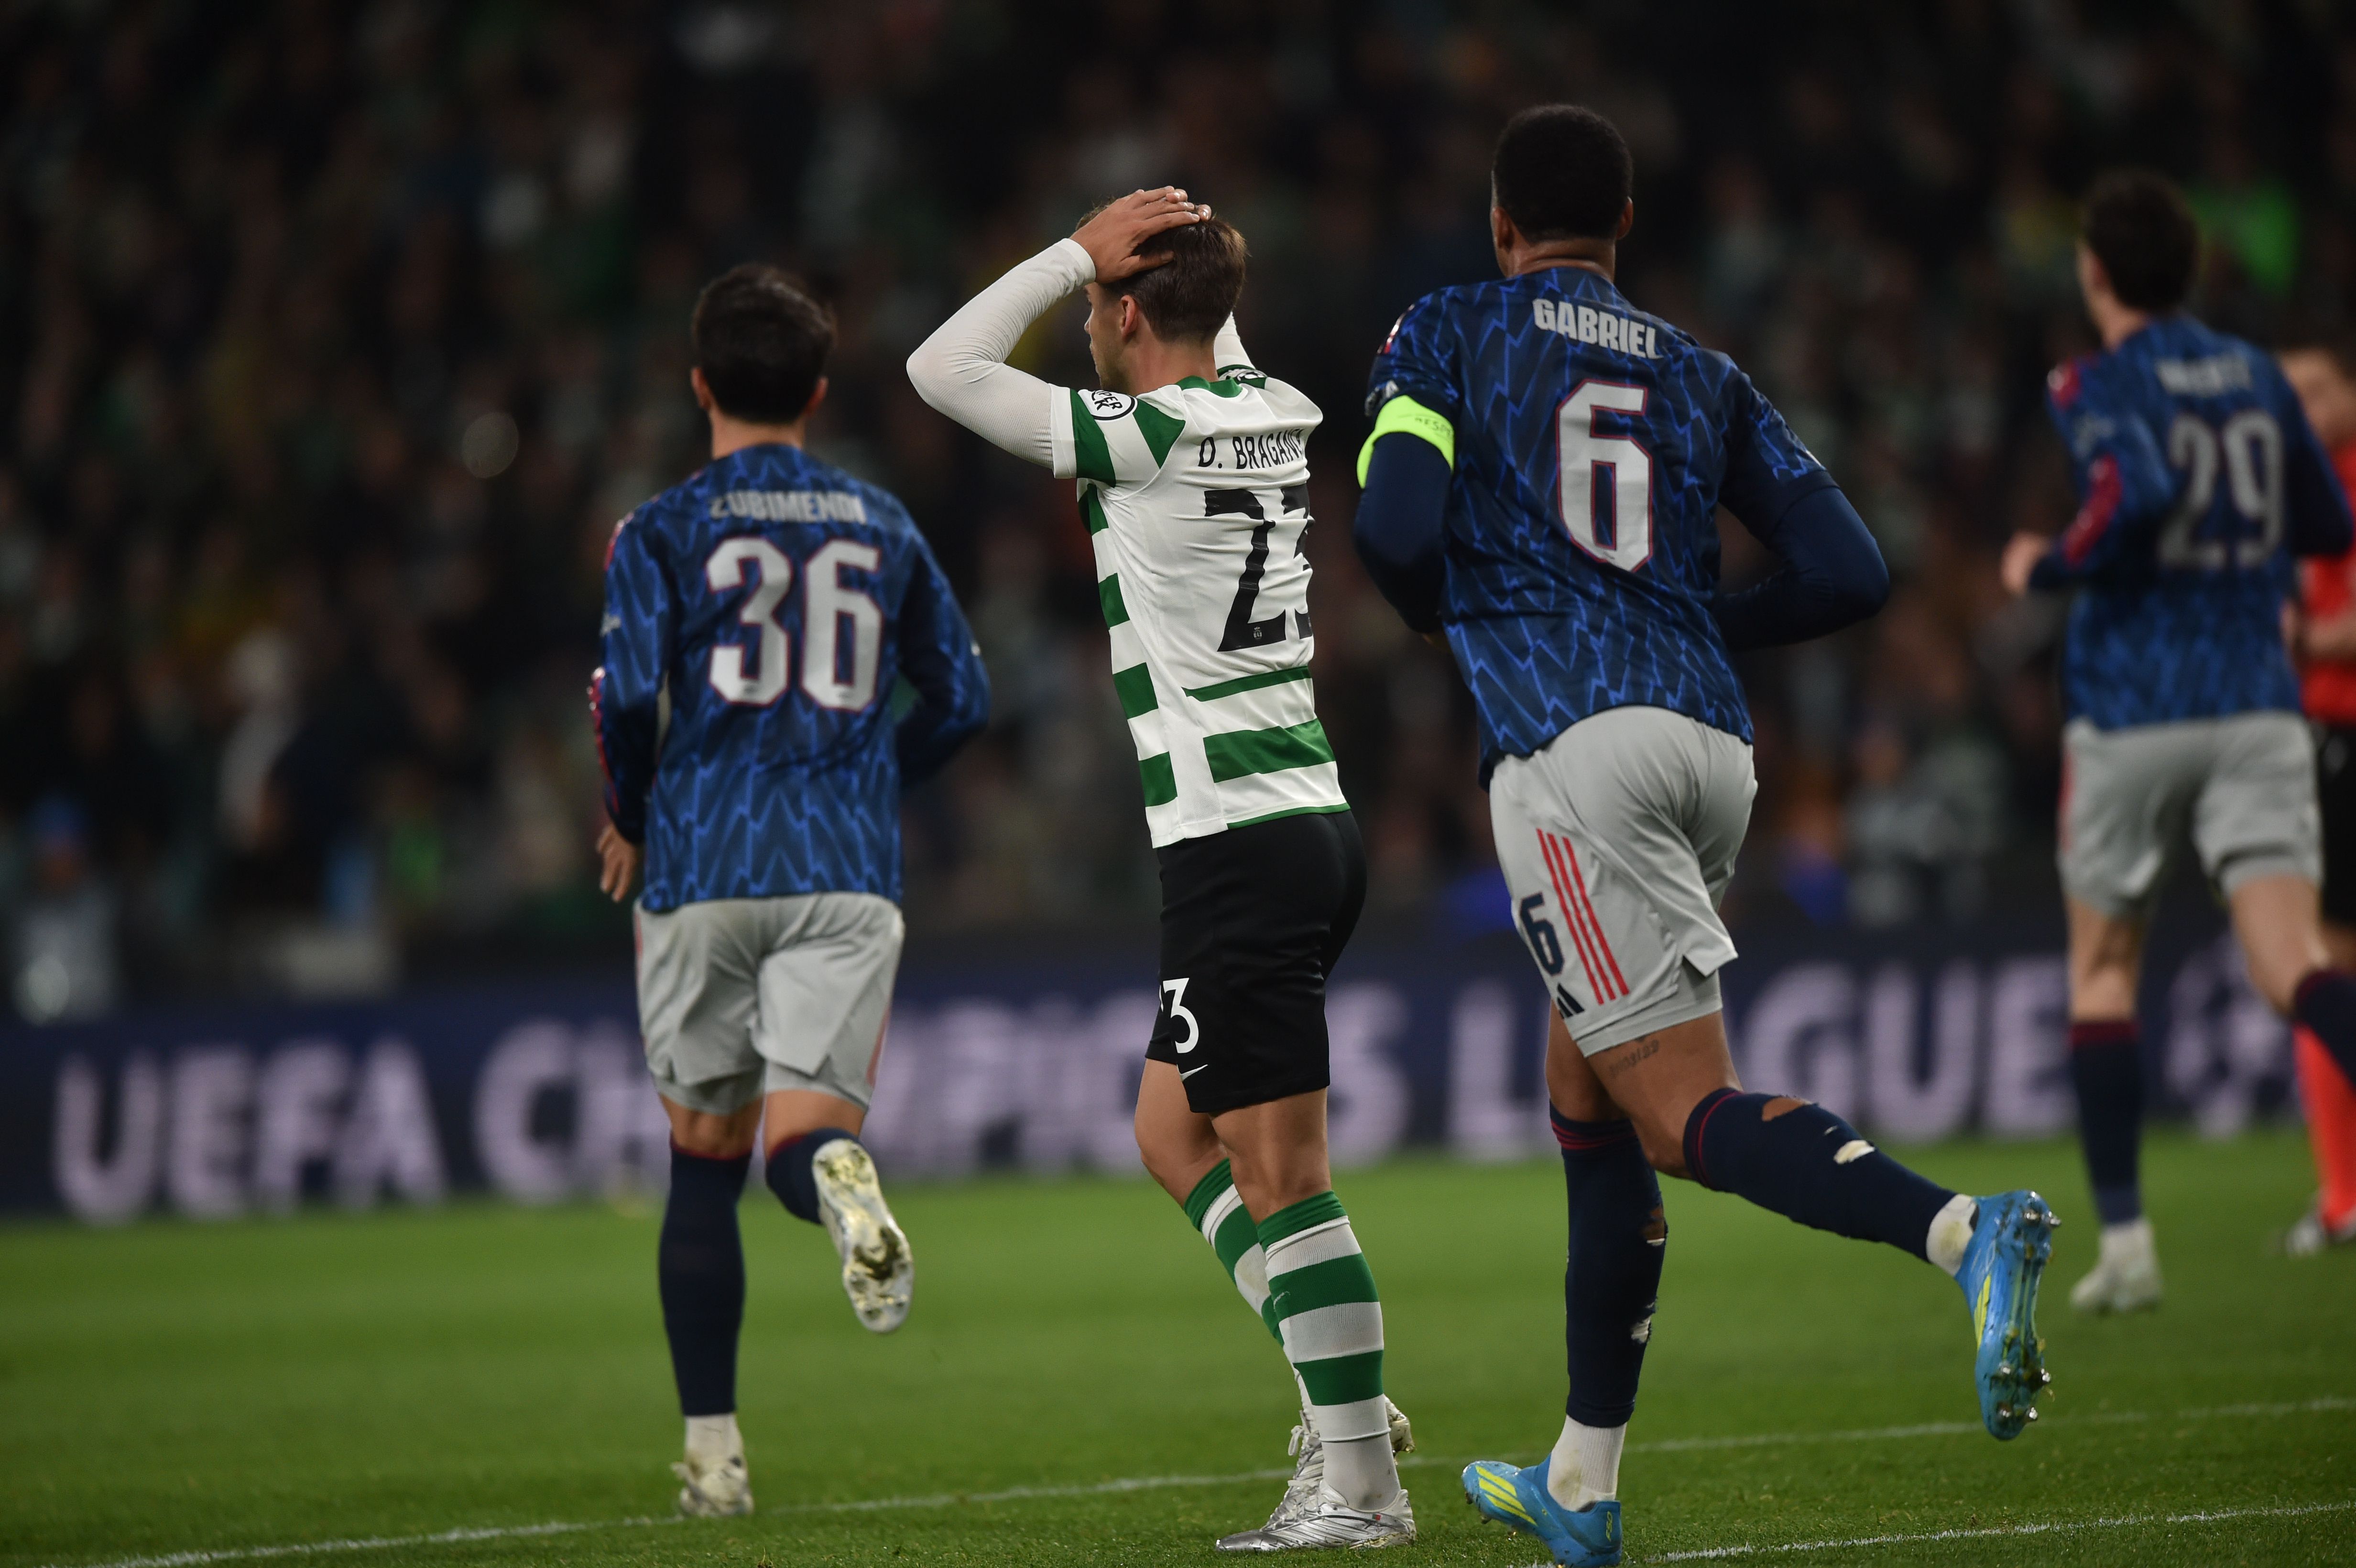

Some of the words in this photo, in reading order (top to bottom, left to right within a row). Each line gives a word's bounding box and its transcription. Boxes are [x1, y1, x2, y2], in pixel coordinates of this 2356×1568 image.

[1532, 298, 1664, 359] GABRIEL
[1198, 436, 1222, 469] D.
[1556, 379, 1653, 572] 6
[2160, 413, 2283, 567] 29
[704, 534, 883, 714] 36
[1519, 891, 1565, 976] 6
[1159, 977, 1199, 1054] 3
[52, 1033, 449, 1226] UEFA
[1446, 957, 2074, 1164] LGUE
